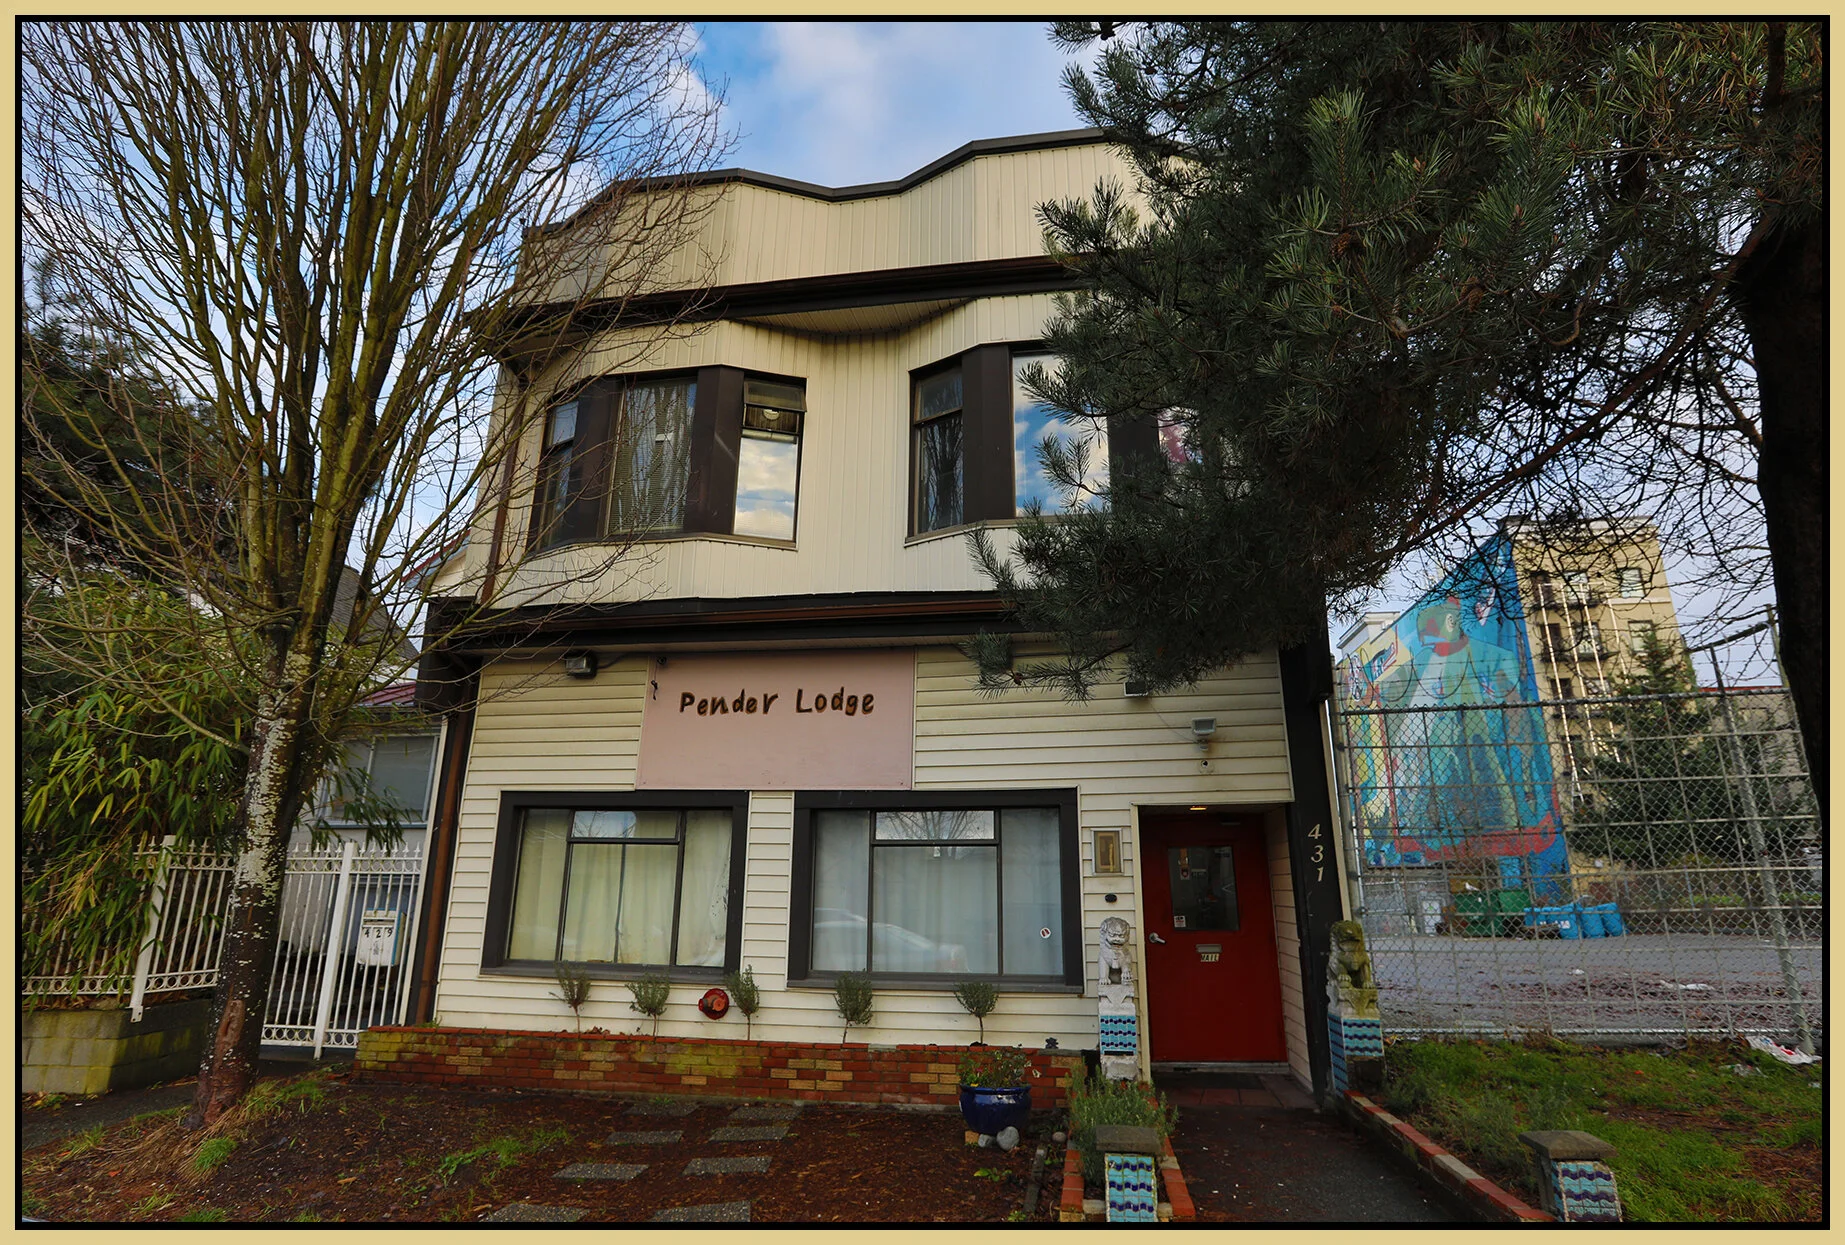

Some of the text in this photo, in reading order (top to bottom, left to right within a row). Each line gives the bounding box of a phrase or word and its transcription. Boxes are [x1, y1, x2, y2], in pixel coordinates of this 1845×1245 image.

[679, 686, 875, 717] Pender Lodge
[1307, 823, 1324, 882] 431
